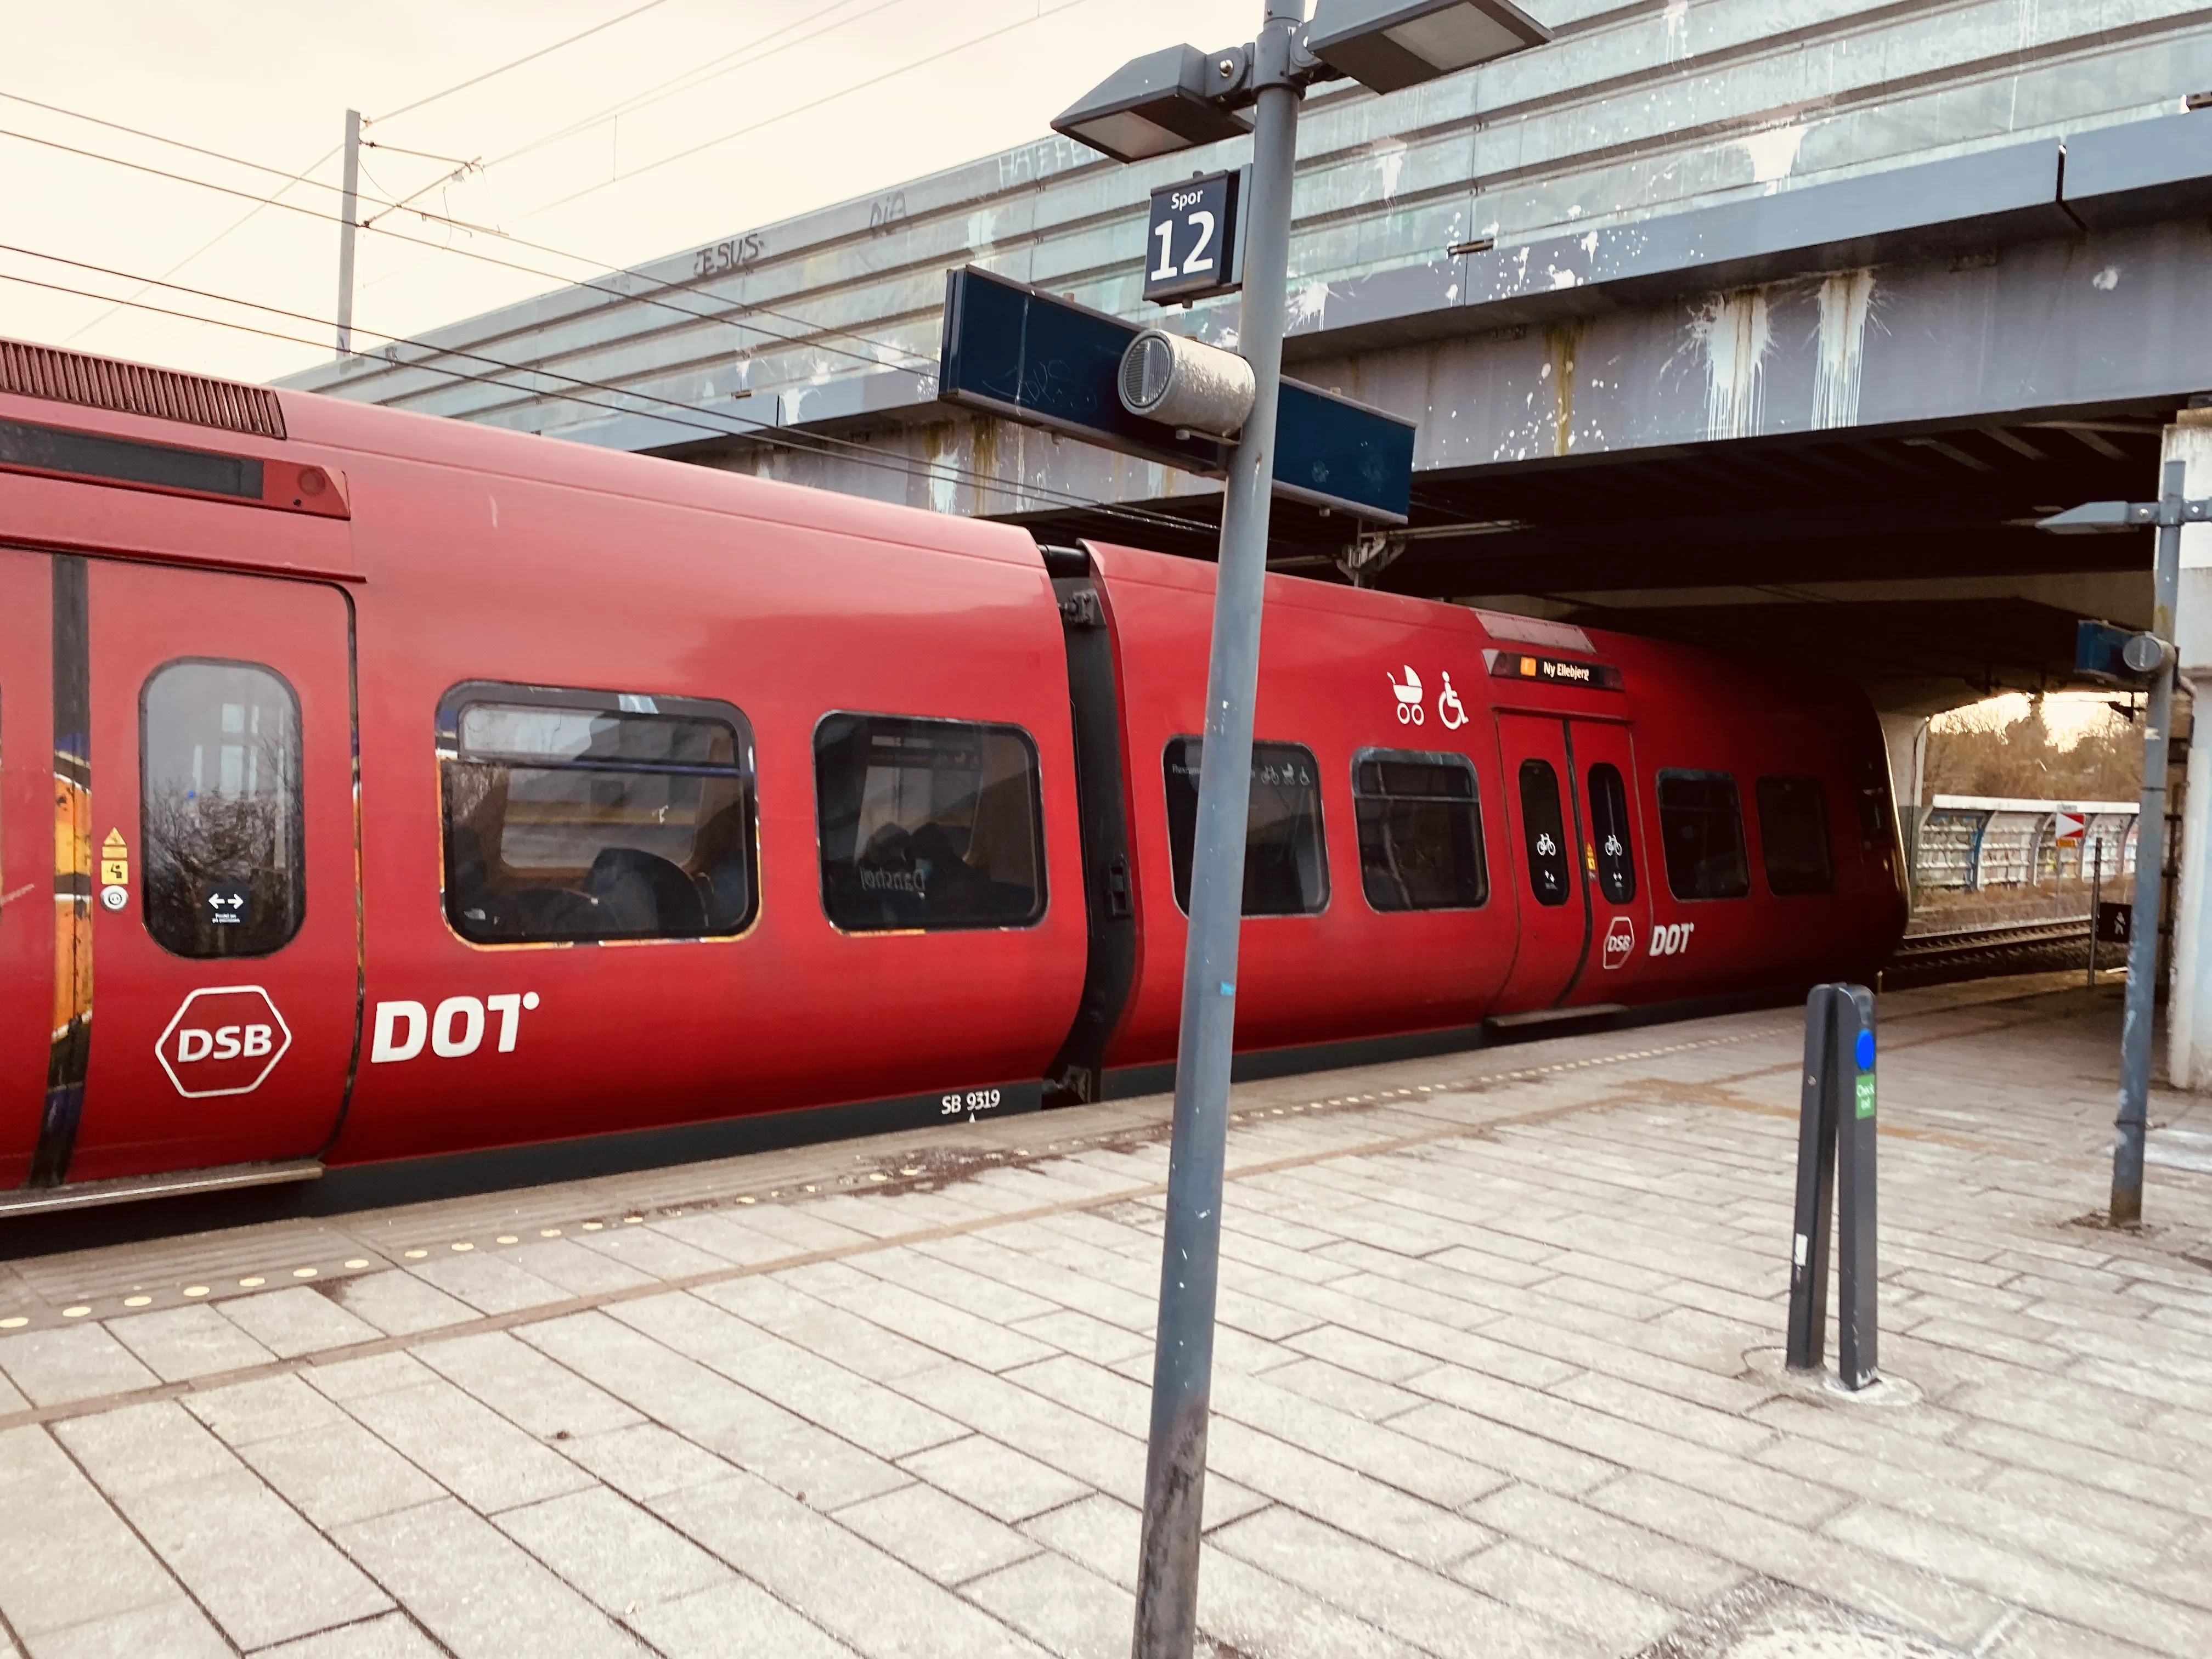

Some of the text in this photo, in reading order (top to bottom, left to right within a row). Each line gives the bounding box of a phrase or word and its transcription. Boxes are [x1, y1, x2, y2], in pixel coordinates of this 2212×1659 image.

[1171, 189, 1203, 211] Spor
[1150, 211, 1215, 281] 12
[1543, 661, 1555, 678] Ny
[1557, 663, 1589, 681] Ellebjerg
[1607, 934, 1631, 952] DSB
[1649, 922, 1694, 956] DOT
[371, 991, 539, 1063] DOT
[177, 1023, 272, 1063] DSB
[941, 1089, 1000, 1115] SB 9319
